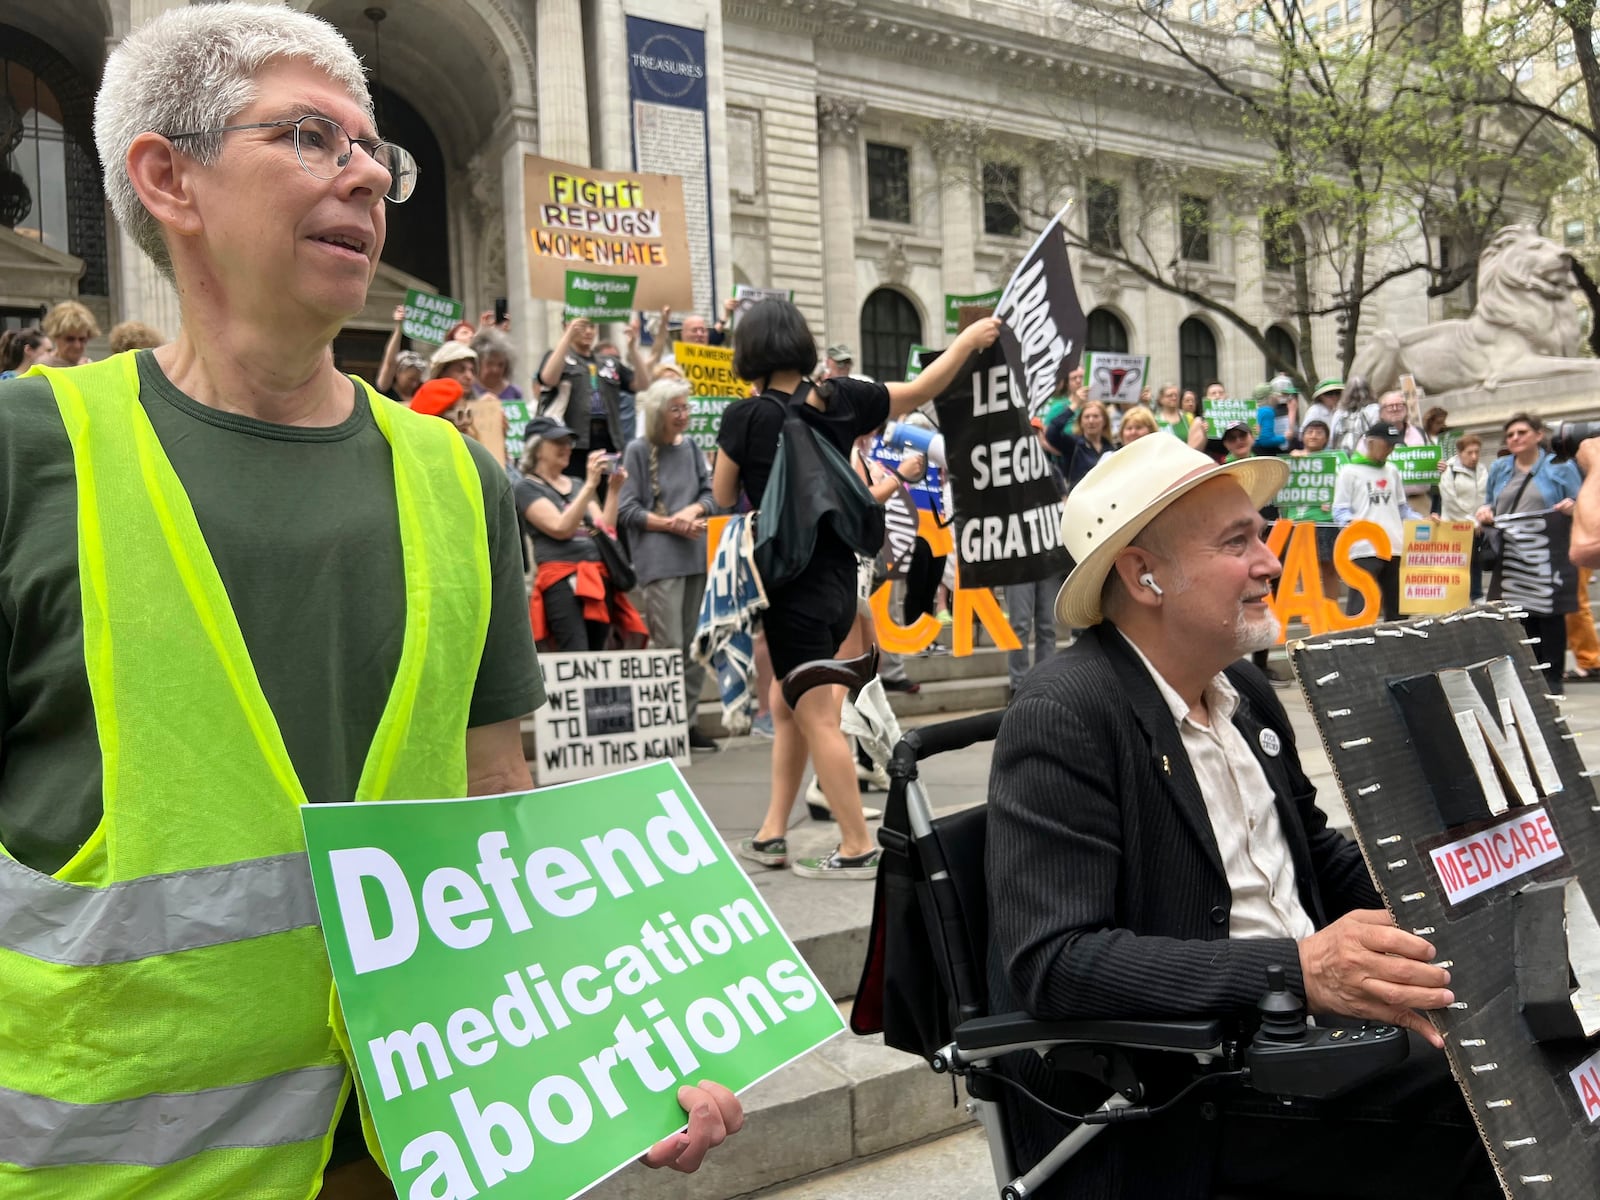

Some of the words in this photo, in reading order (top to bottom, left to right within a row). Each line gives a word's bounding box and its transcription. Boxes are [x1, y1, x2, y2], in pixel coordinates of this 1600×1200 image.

[632, 53, 703, 79] TREASURES
[552, 175, 640, 208] FIGHT
[572, 277, 631, 293] Abortion
[594, 293, 607, 305] is
[415, 293, 455, 317] BANS
[970, 434, 1051, 491] SEGU
[1297, 473, 1336, 488] OUR
[1407, 542, 1450, 553] ABORTION
[1452, 541, 1461, 553] IS
[1405, 573, 1450, 585] ABORTION
[1452, 573, 1461, 586] IS
[556, 657, 612, 681] CAN'T
[620, 654, 684, 679] BELIEVE
[547, 689, 581, 712] WE
[639, 681, 681, 704] HAVE
[548, 717, 581, 739] TO
[638, 706, 686, 728] DEAL
[544, 742, 594, 771] WITH
[599, 740, 639, 766] THIS
[643, 735, 686, 760] AGAIN
[1435, 815, 1558, 894] MEDICARE
[329, 789, 719, 975] Defend
[368, 896, 770, 1102] medication
[399, 958, 818, 1200] abortions
